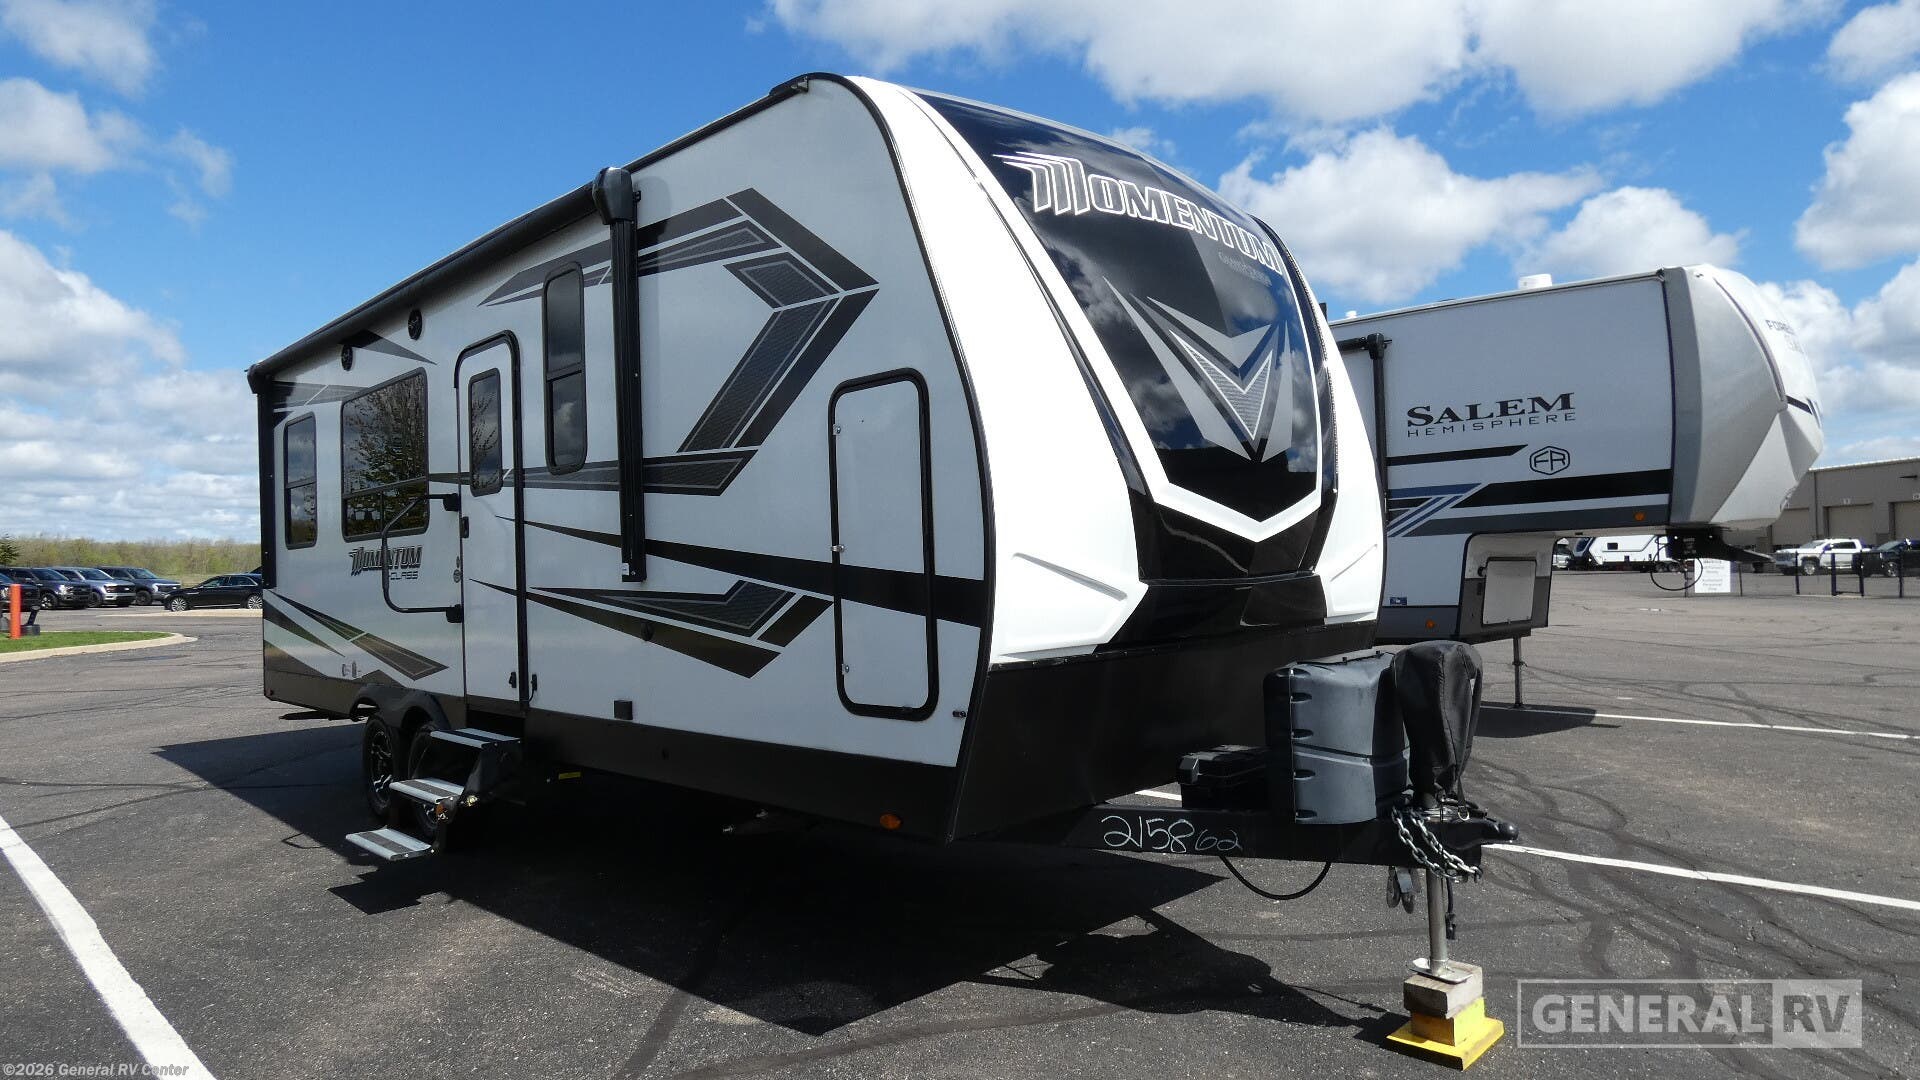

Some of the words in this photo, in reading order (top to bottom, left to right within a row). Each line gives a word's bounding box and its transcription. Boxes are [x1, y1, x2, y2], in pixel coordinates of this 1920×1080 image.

[992, 151, 1282, 275] MOMENTUM
[1407, 392, 1576, 427] SALEM
[1407, 412, 1577, 438] HEMISPHERE
[348, 545, 423, 576] MOMNTUM
